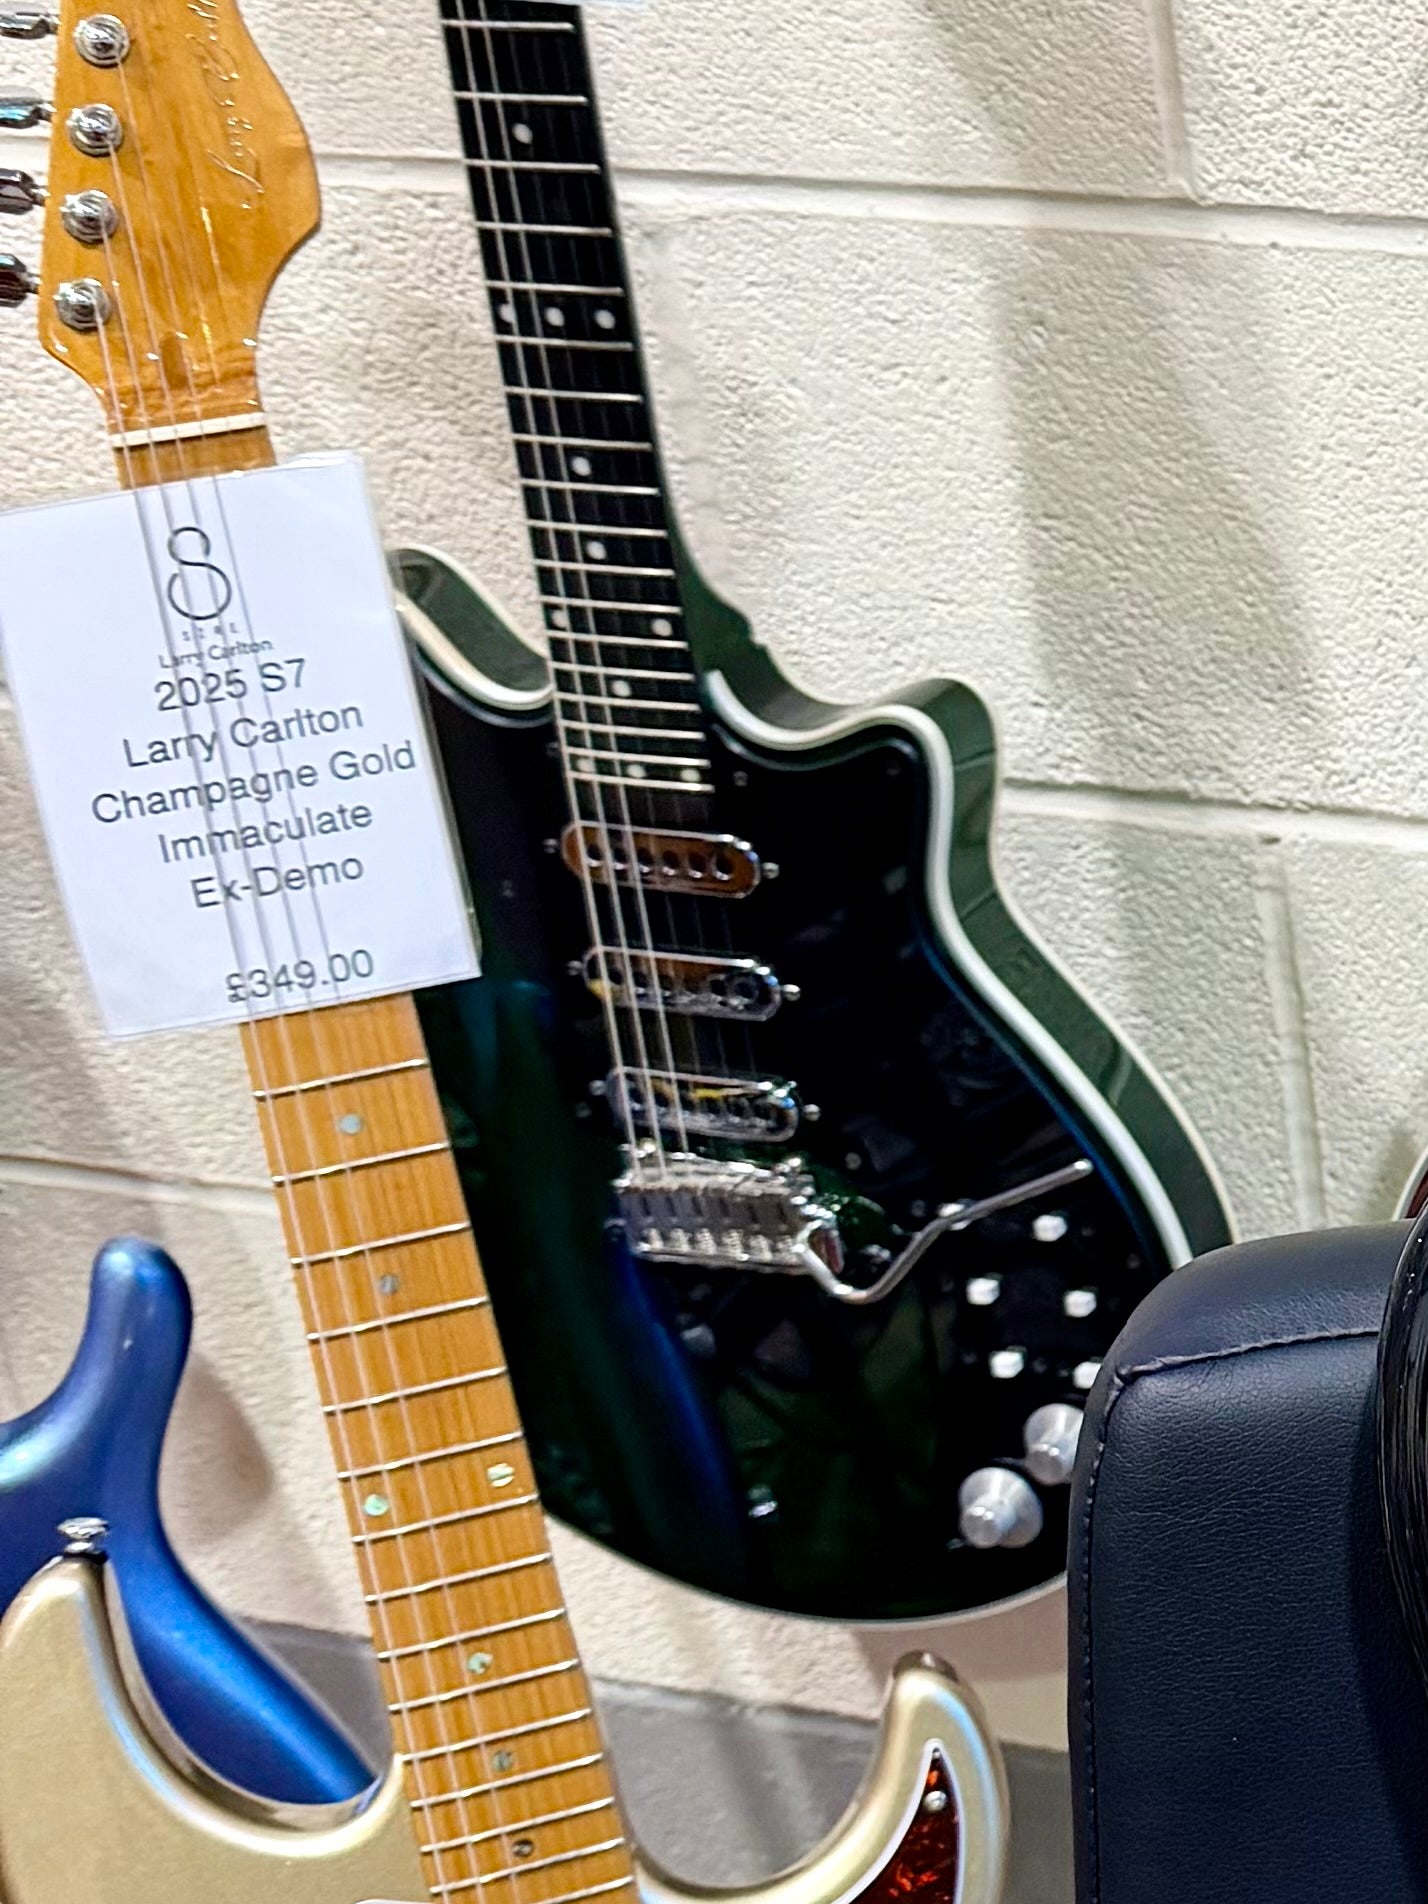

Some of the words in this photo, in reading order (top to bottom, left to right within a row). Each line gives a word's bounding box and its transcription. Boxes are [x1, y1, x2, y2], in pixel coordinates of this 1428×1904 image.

[154, 668, 248, 712] 2025
[260, 658, 307, 694] S7
[123, 729, 220, 769] Larry
[229, 703, 365, 749] Carlton
[92, 763, 320, 825] Champagne
[329, 739, 417, 782] Gold
[158, 802, 374, 864] Immaculate
[190, 857, 365, 908] Ex-Demo
[225, 949, 375, 1003] £349.00
